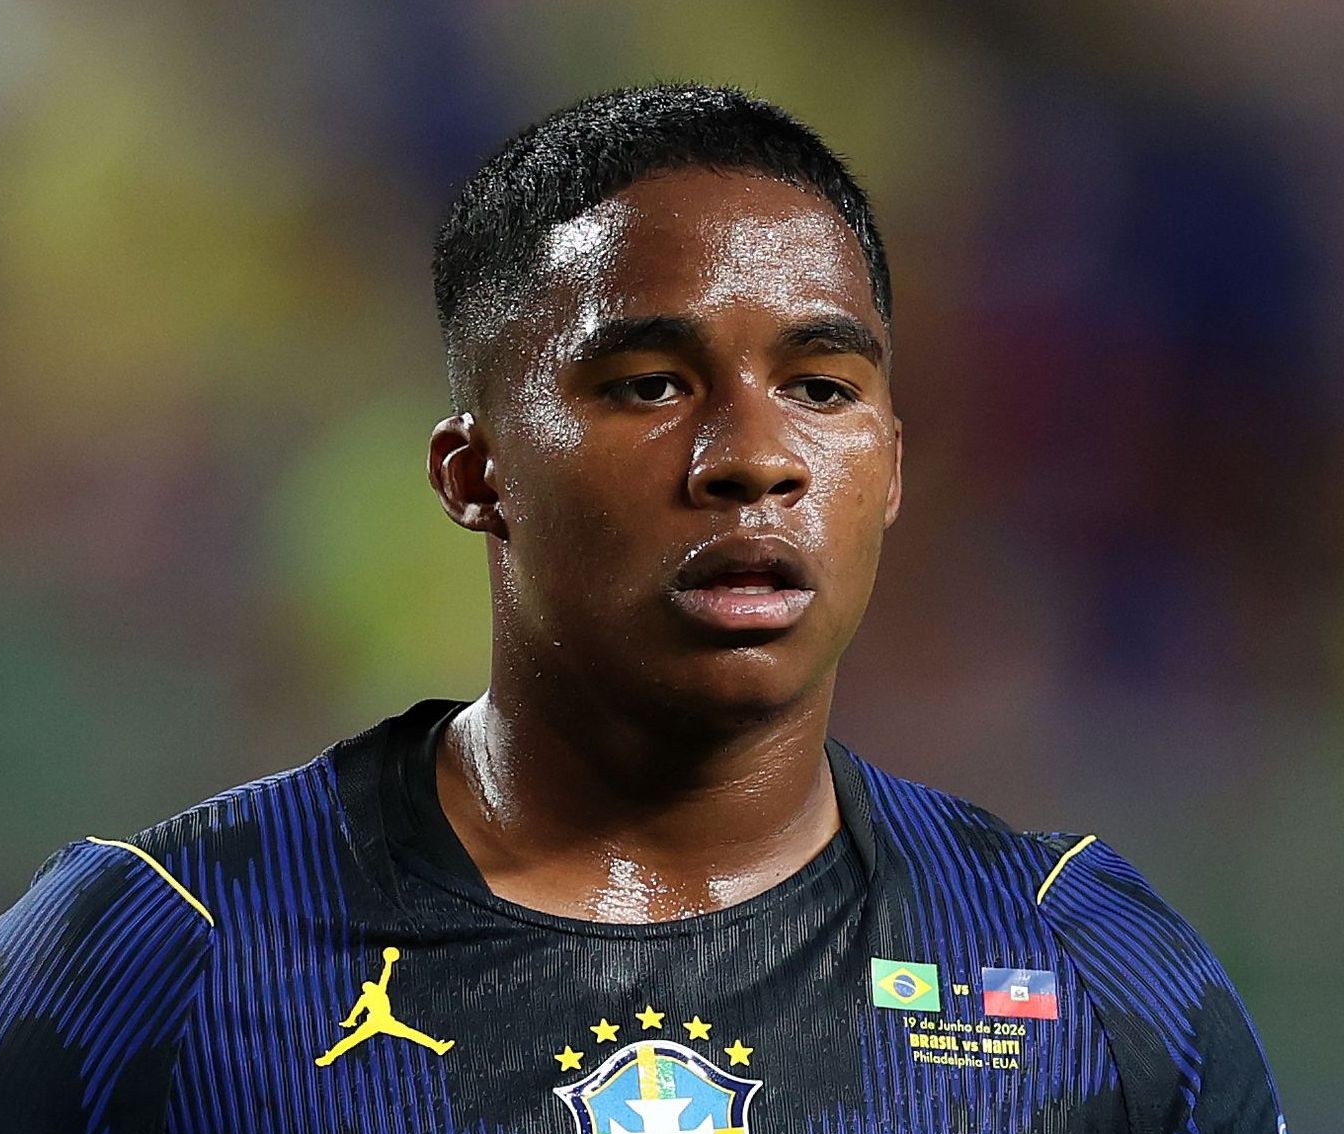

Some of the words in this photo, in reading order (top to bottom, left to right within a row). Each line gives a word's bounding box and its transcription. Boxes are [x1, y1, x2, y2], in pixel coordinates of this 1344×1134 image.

[902, 1016, 916, 1027] 19
[920, 1017, 934, 1029] de
[938, 1018, 972, 1032] Junho
[976, 1020, 990, 1033] de
[993, 1022, 1025, 1035] 2026
[961, 1040, 978, 1051] vs
[913, 1050, 982, 1068] Philadelphia
[992, 1057, 1018, 1068] EUA
